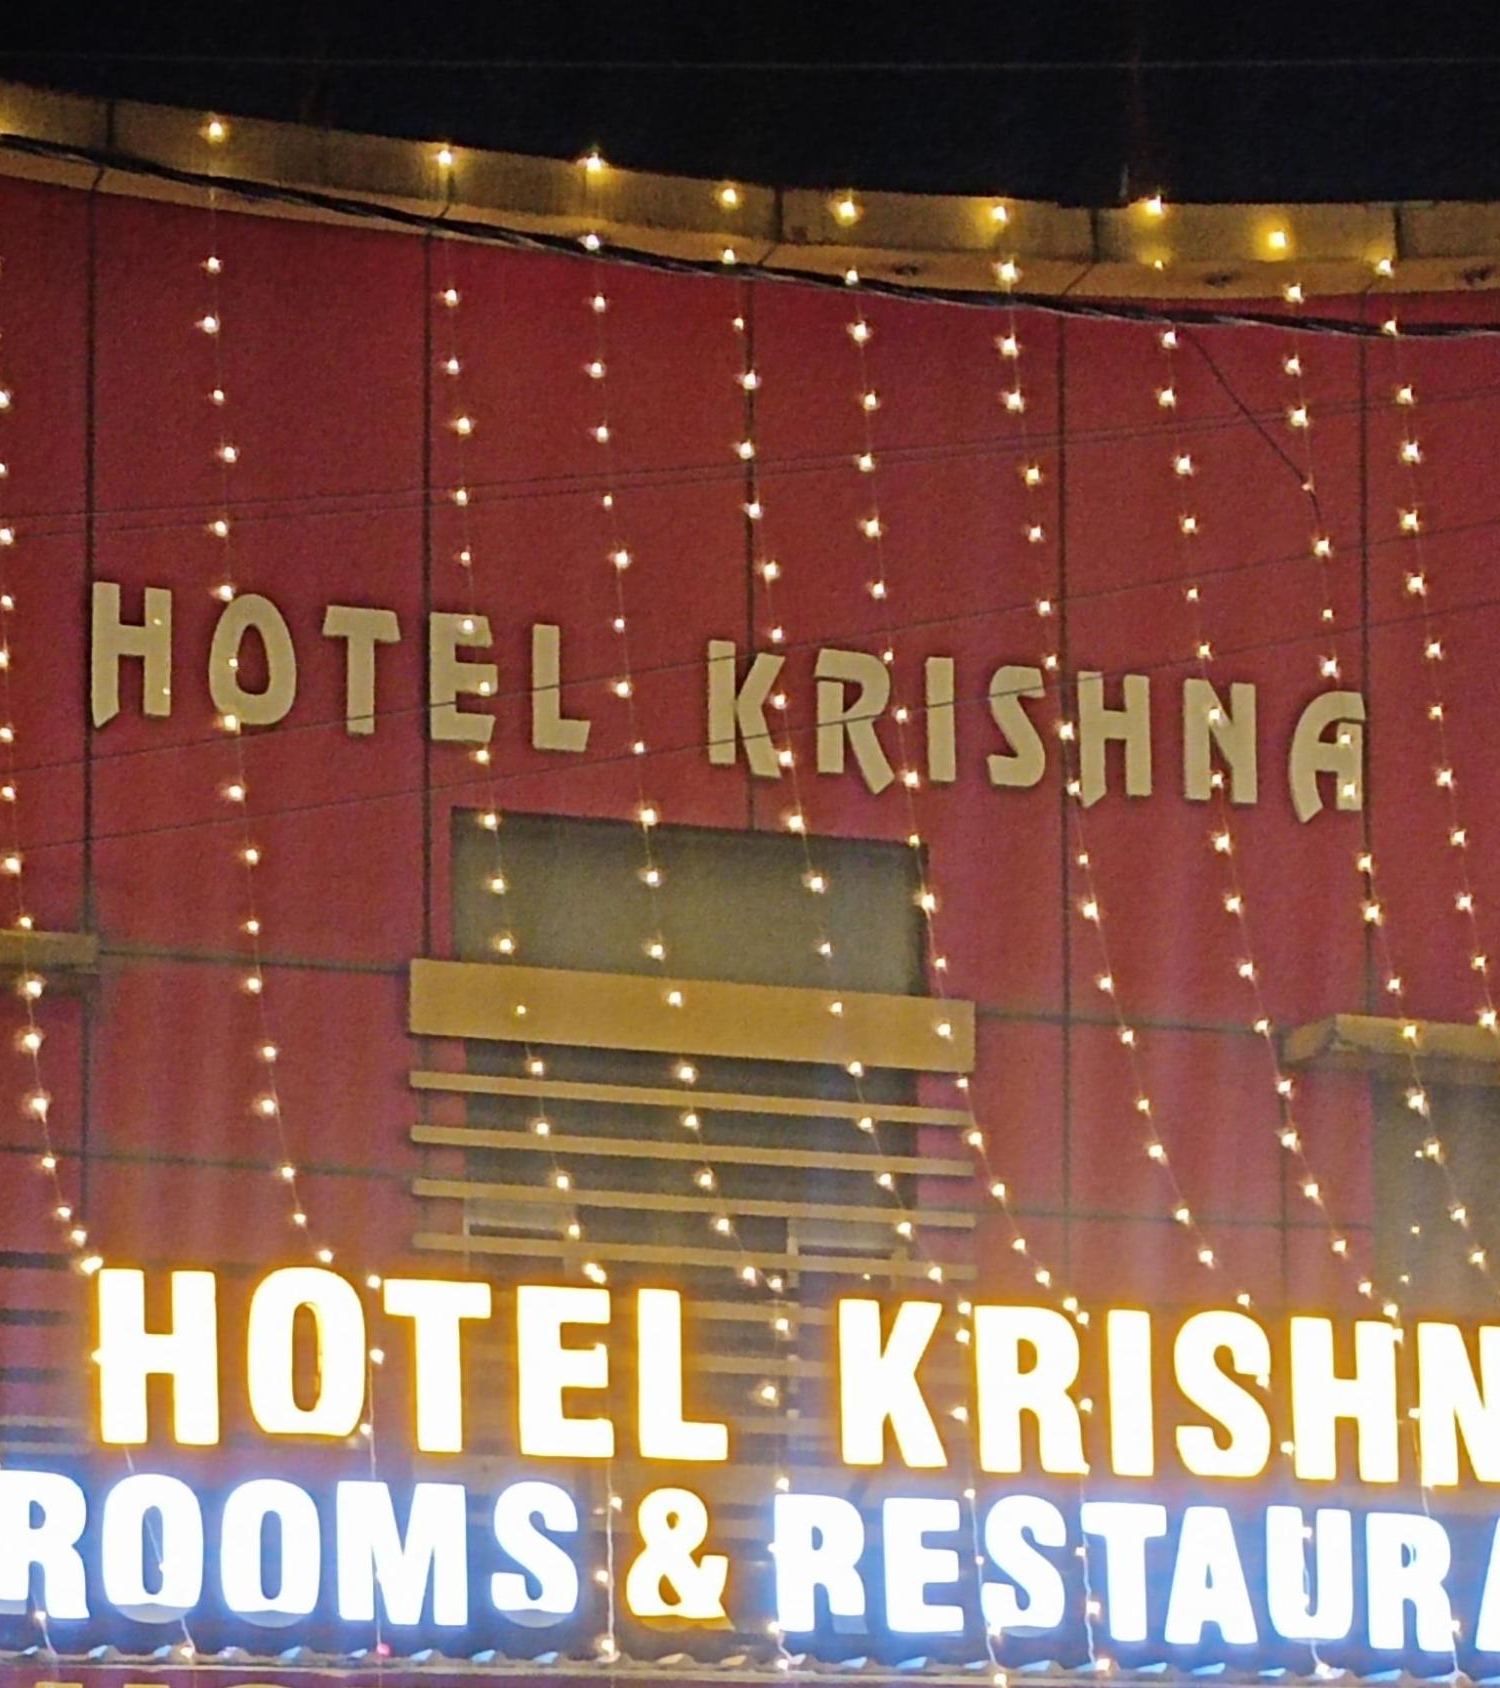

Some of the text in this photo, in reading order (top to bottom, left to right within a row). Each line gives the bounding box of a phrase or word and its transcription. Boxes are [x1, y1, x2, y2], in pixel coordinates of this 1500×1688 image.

[90, 580, 1367, 824] HOTEL KRISHNA
[97, 1266, 729, 1462] HOTEL
[626, 1487, 730, 1626] &
